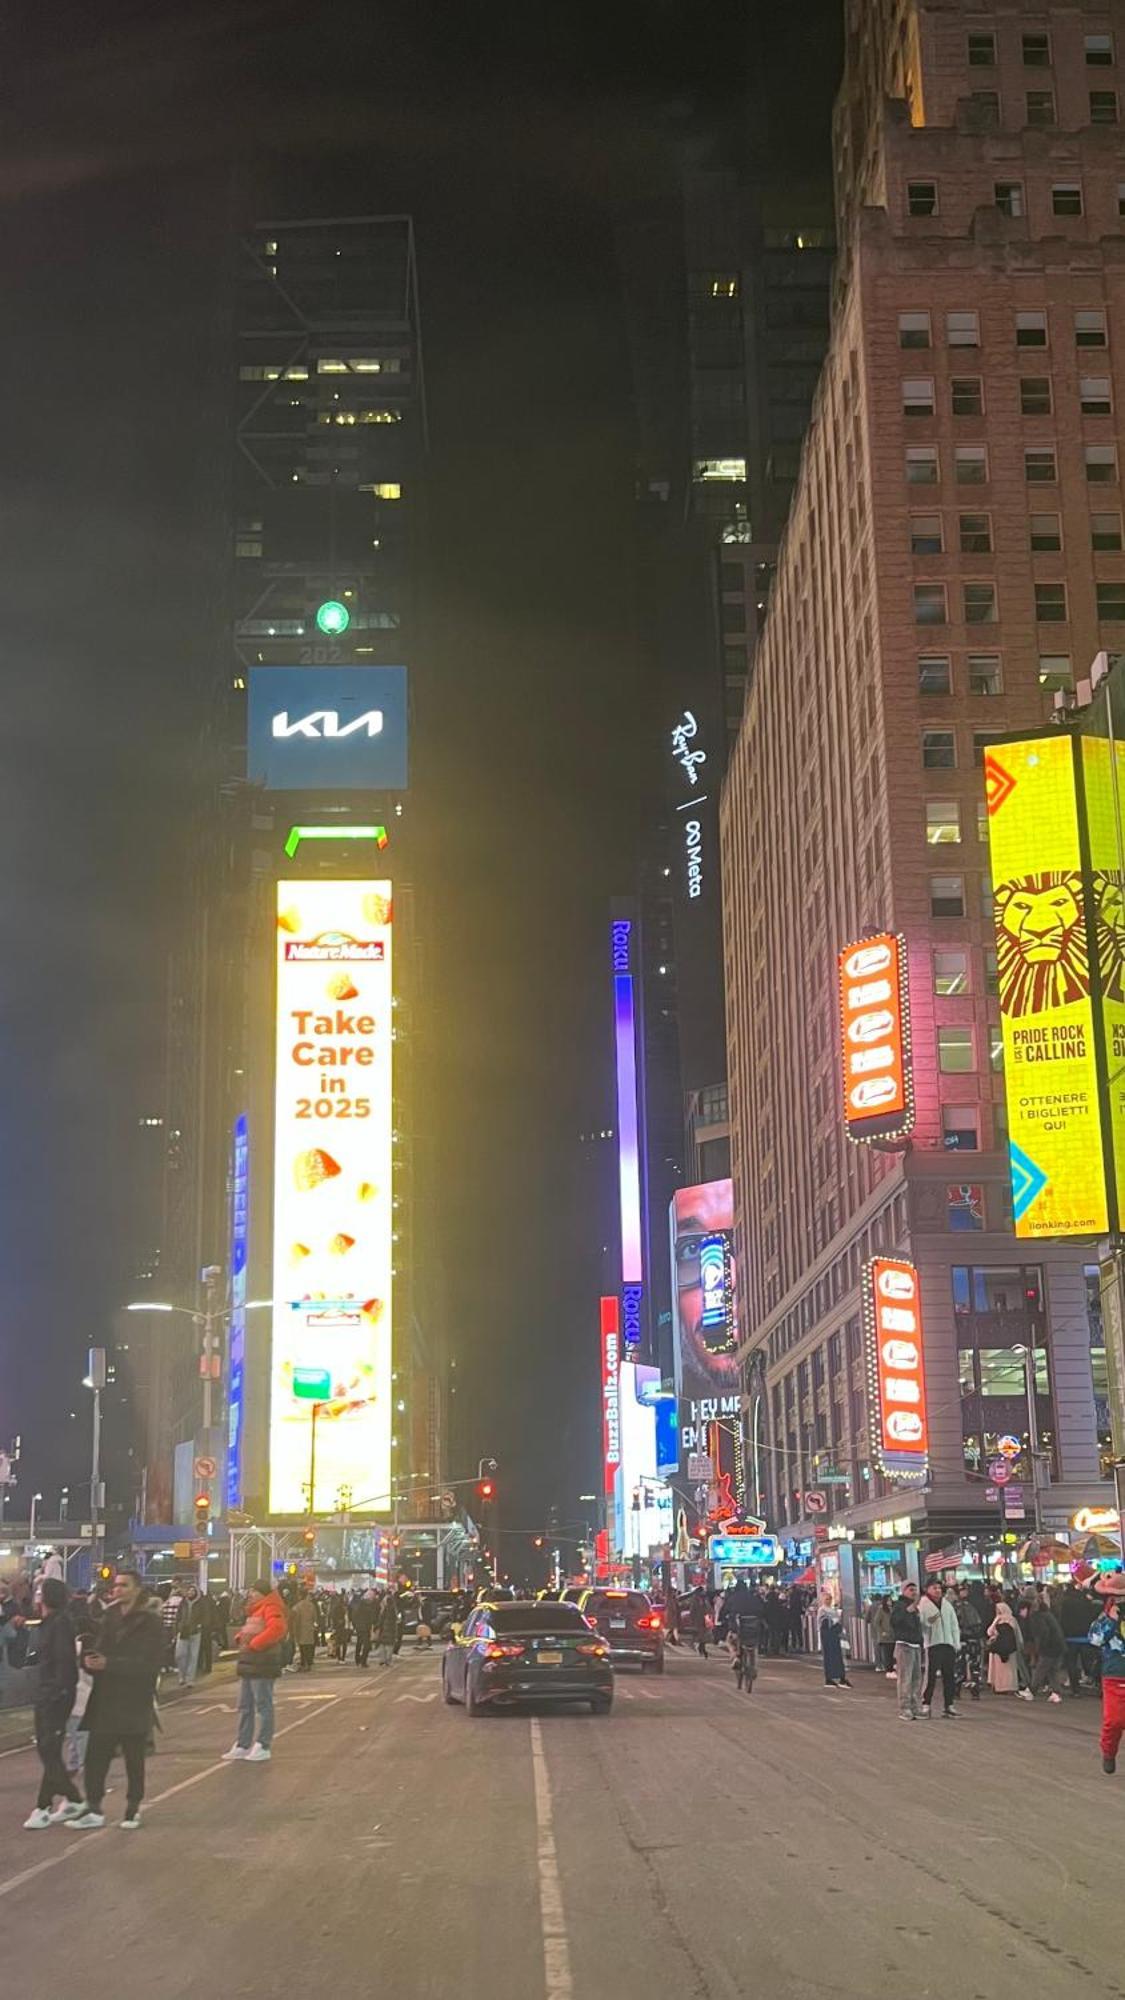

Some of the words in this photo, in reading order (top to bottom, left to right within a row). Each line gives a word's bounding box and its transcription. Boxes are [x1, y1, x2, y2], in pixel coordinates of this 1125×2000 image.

[272, 710, 384, 737] KIA
[687, 845, 703, 898] Meta
[291, 1010, 375, 1035] Take
[1013, 1026, 1048, 1046] PRIDE
[1052, 1023, 1085, 1042] ROCK
[291, 1041, 375, 1067] Care
[1025, 1040, 1087, 1063] CALLING
[319, 1073, 346, 1093] in
[294, 1098, 372, 1119] 2025
[1019, 1092, 1088, 1107] OTTENERE
[1027, 1106, 1089, 1119] BIGLIETTI
[1043, 1120, 1066, 1131] QUI
[1028, 1217, 1096, 1231] lionking.com
[604, 1333, 620, 1463] BuzzBallz.com
